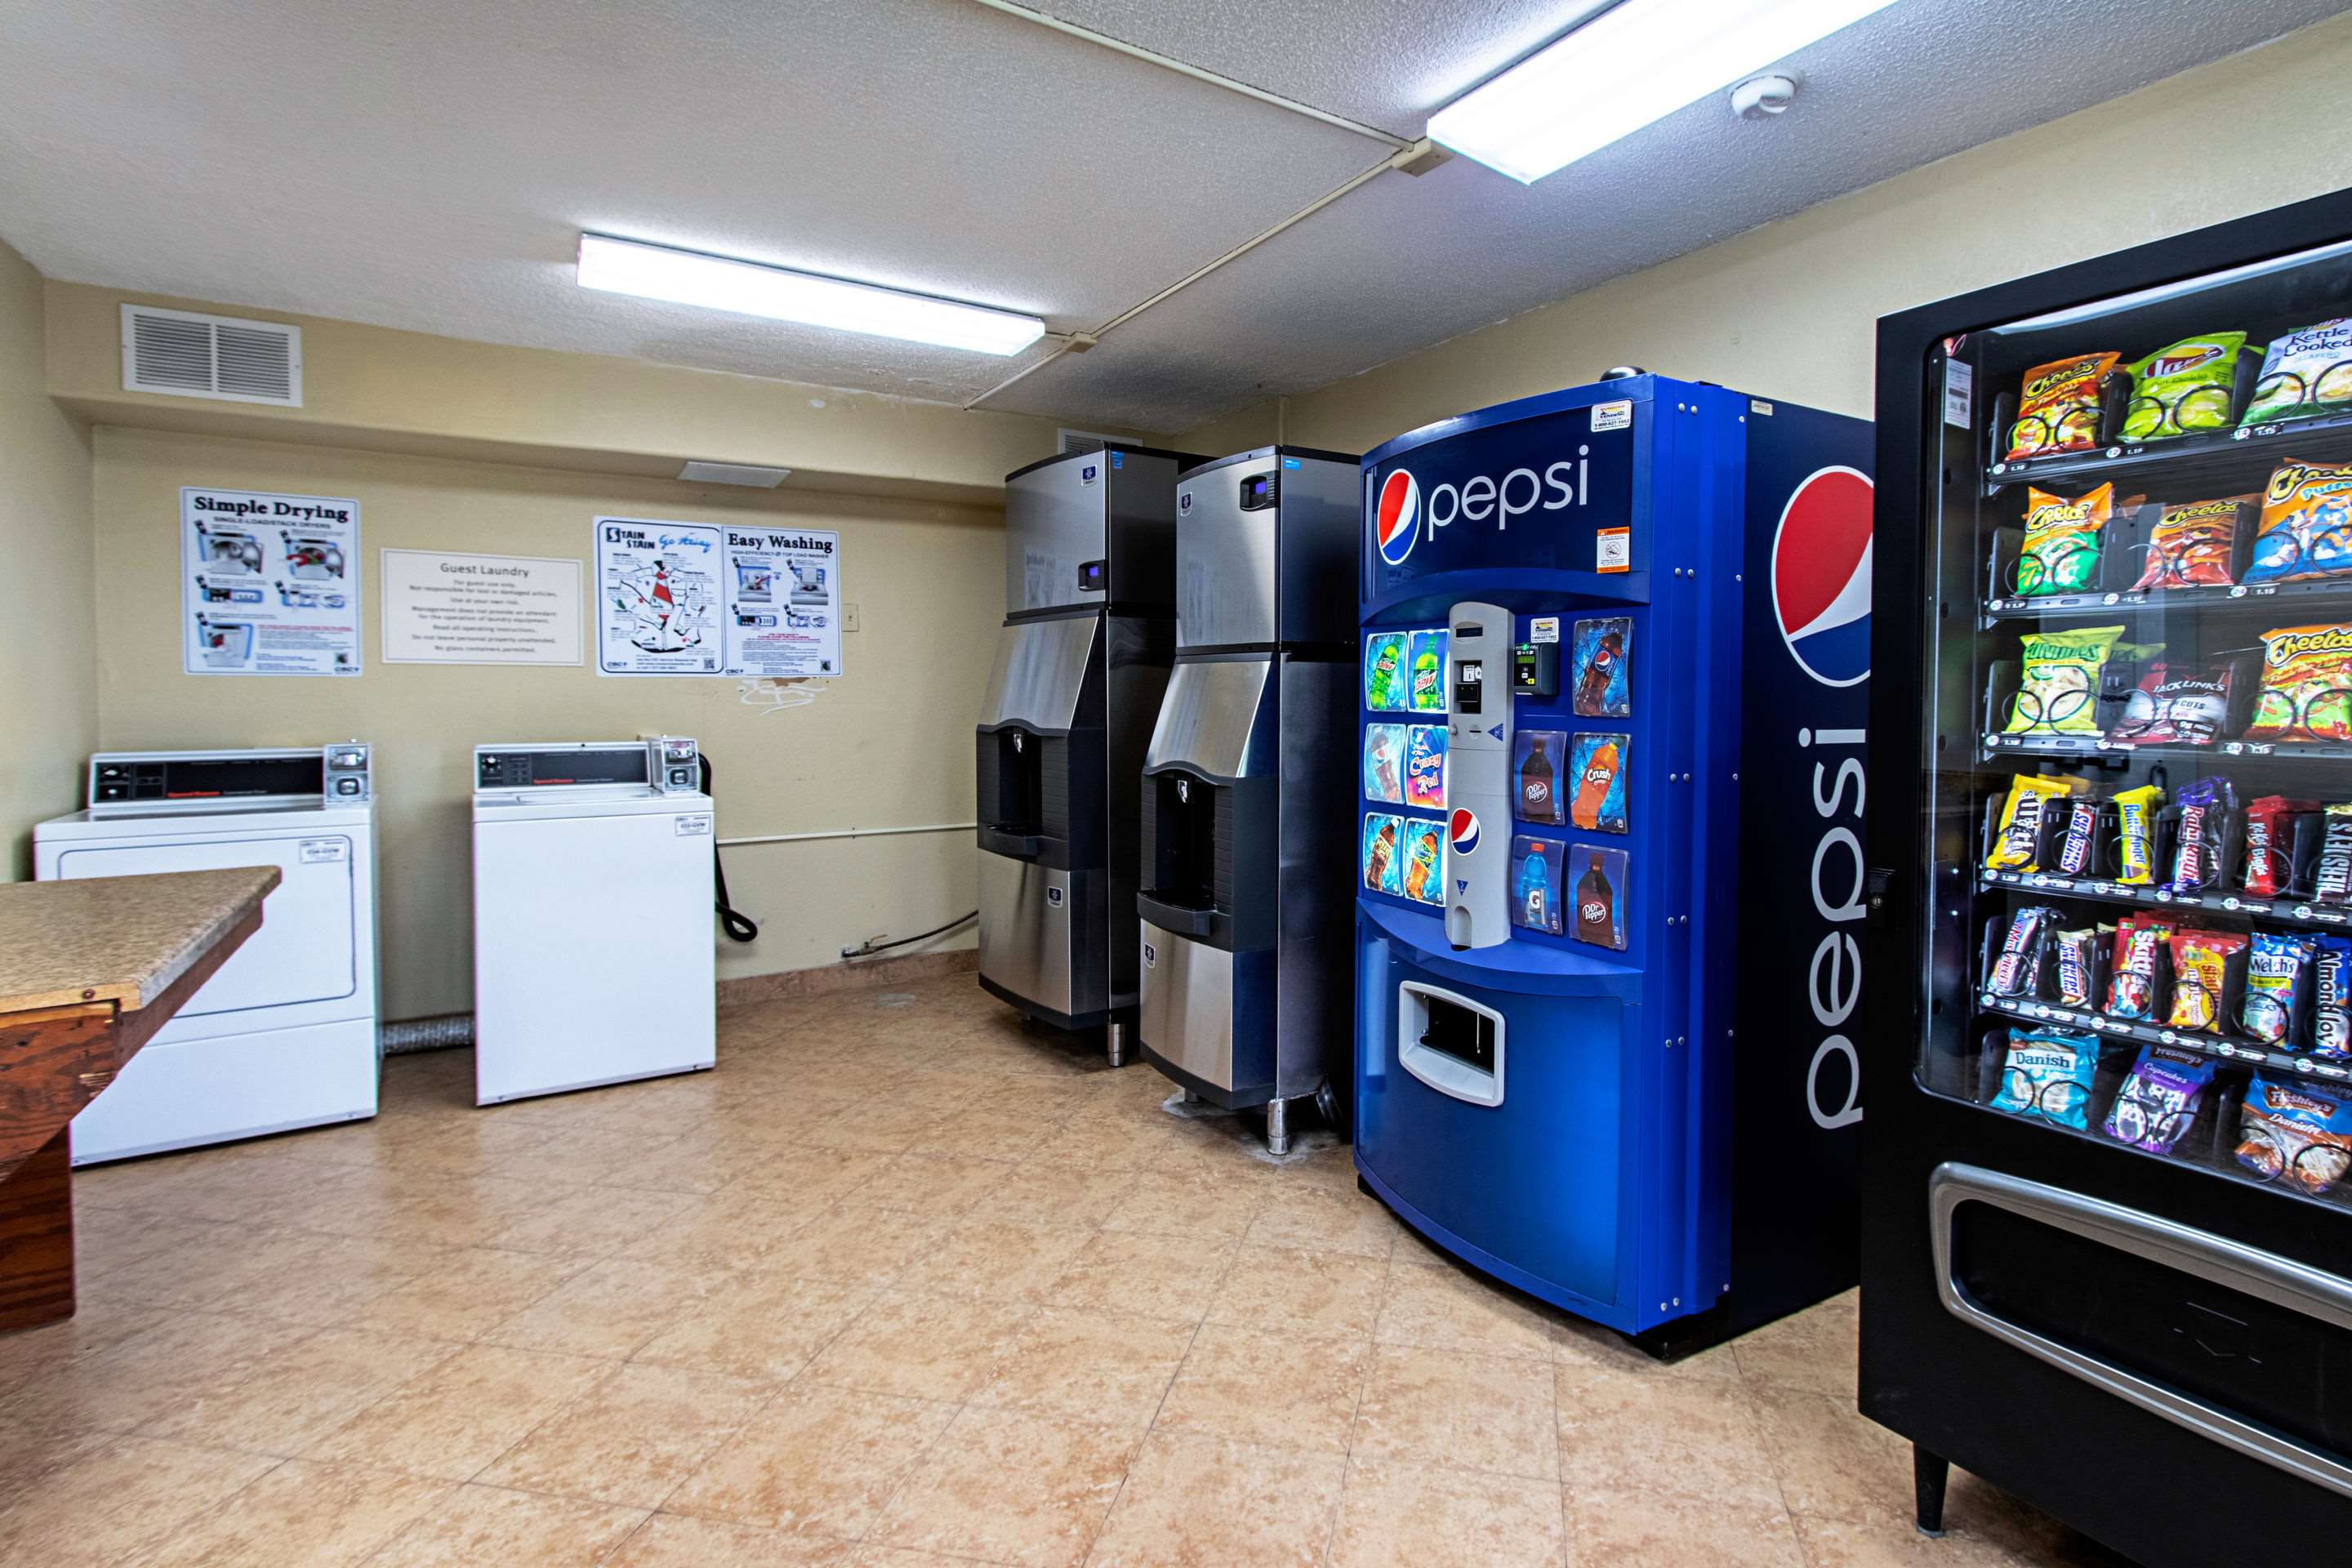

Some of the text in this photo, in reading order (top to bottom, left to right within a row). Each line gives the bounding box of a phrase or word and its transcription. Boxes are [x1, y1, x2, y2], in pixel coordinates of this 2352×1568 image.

[2292, 327, 2350, 345] Kettle
[2026, 359, 2100, 399] Cheetos
[1428, 444, 1589, 542] pepsi
[194, 497, 349, 523] Simple Drying
[2028, 504, 2090, 531] Cheetos
[2158, 501, 2238, 526] Cheetos
[627, 540, 655, 550] STAIN
[728, 533, 833, 554] Easy Washing
[440, 563, 529, 578] Guest Laundry
[2256, 587, 2275, 595] 1.15
[2268, 628, 2352, 666] Cheetos
[2153, 680, 2226, 693] JACK LINK'S
[2181, 701, 2206, 710] CUTS
[1410, 753, 1441, 776] Crazy
[1587, 768, 1610, 782] Crush
[1417, 771, 1438, 795] Red
[1528, 786, 1546, 800] Pepper
[1533, 784, 1541, 792] Dr
[2062, 813, 2089, 871] SNICKERS
[2317, 822, 2350, 893] HERSHEY'S
[1529, 890, 1540, 909] G
[1591, 903, 1599, 911] Dr
[1584, 905, 1605, 920] Pepper
[1799, 726, 1867, 1130] pepsi
[1998, 928, 2023, 986] Museteers
[2318, 951, 2342, 1015] Almond
[2316, 1016, 2341, 1049] Joy
[2016, 1052, 2070, 1067] Danish
[2144, 1062, 2188, 1084] Cupcakes
[2268, 1112, 2322, 1135] Danish
